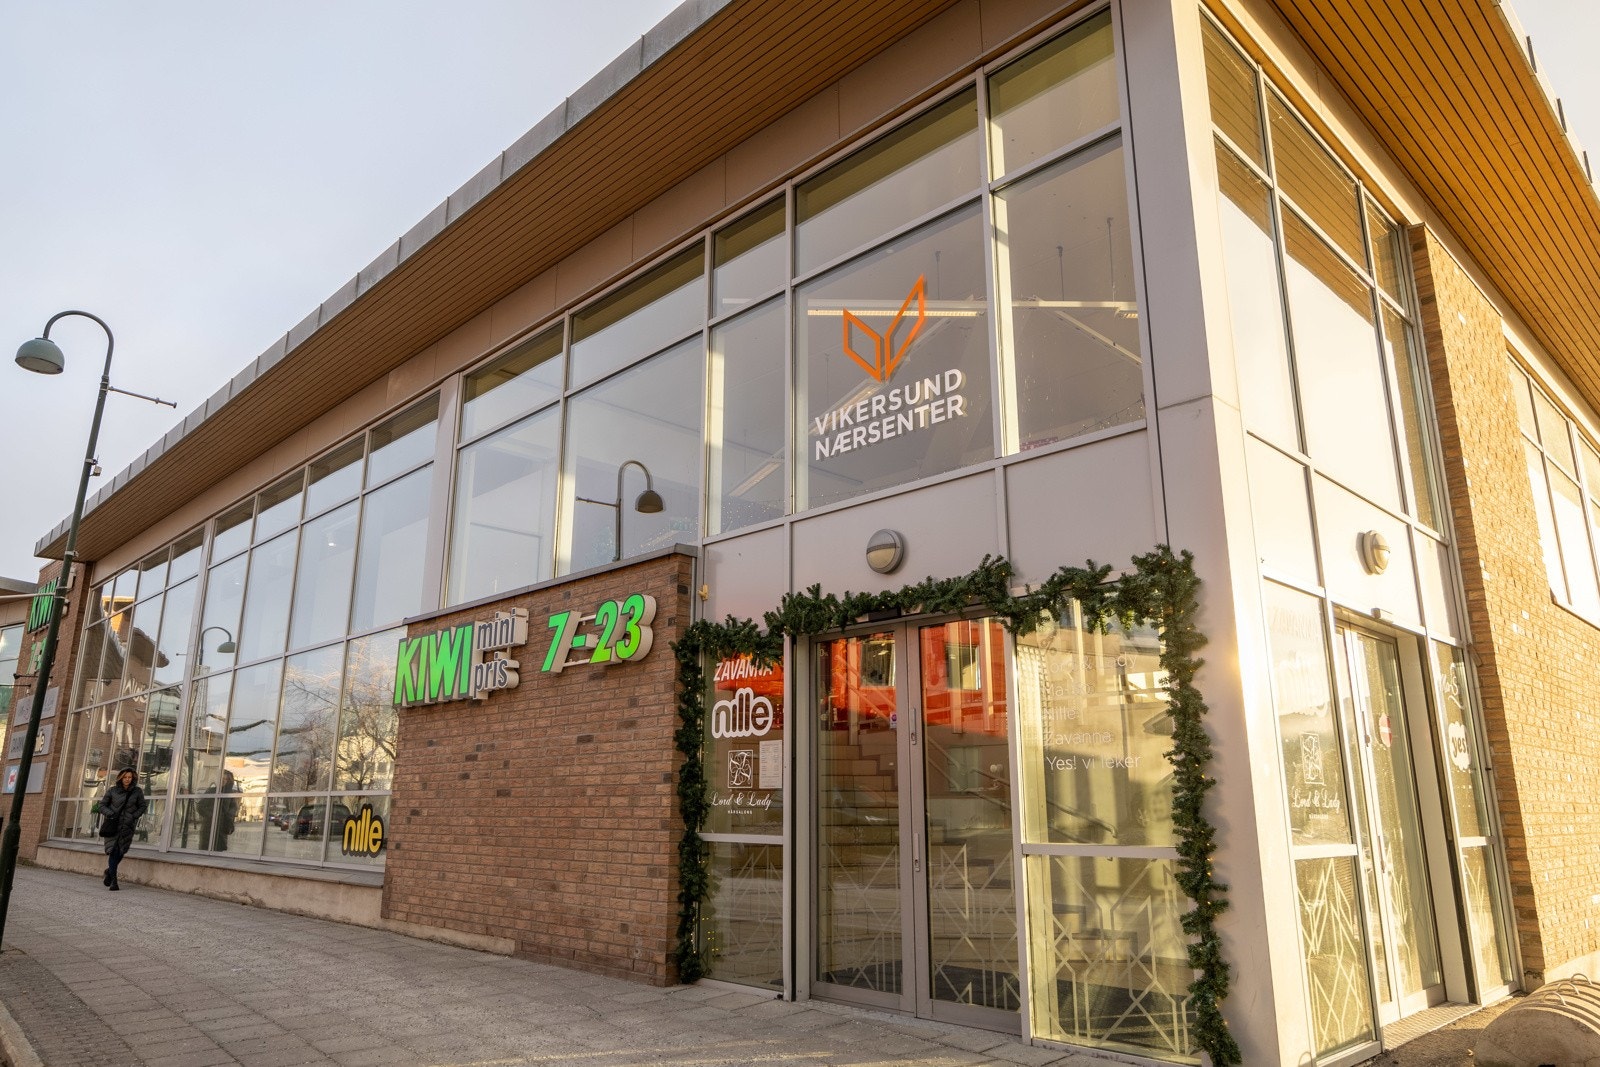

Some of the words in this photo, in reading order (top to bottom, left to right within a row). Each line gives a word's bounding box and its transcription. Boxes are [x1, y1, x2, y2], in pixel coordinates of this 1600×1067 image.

[815, 368, 963, 436] VIKERSUND
[815, 394, 964, 461] NÆRSENTER
[476, 607, 517, 650] mini
[541, 593, 646, 673] 7-23
[394, 624, 475, 705] KIWI
[474, 651, 509, 699] pris
[712, 687, 773, 738] nille
[1046, 755, 1077, 771] Yes!
[1101, 754, 1141, 769] leker
[709, 791, 734, 806] Lord
[747, 791, 771, 811] Lady
[342, 804, 384, 857] nille
